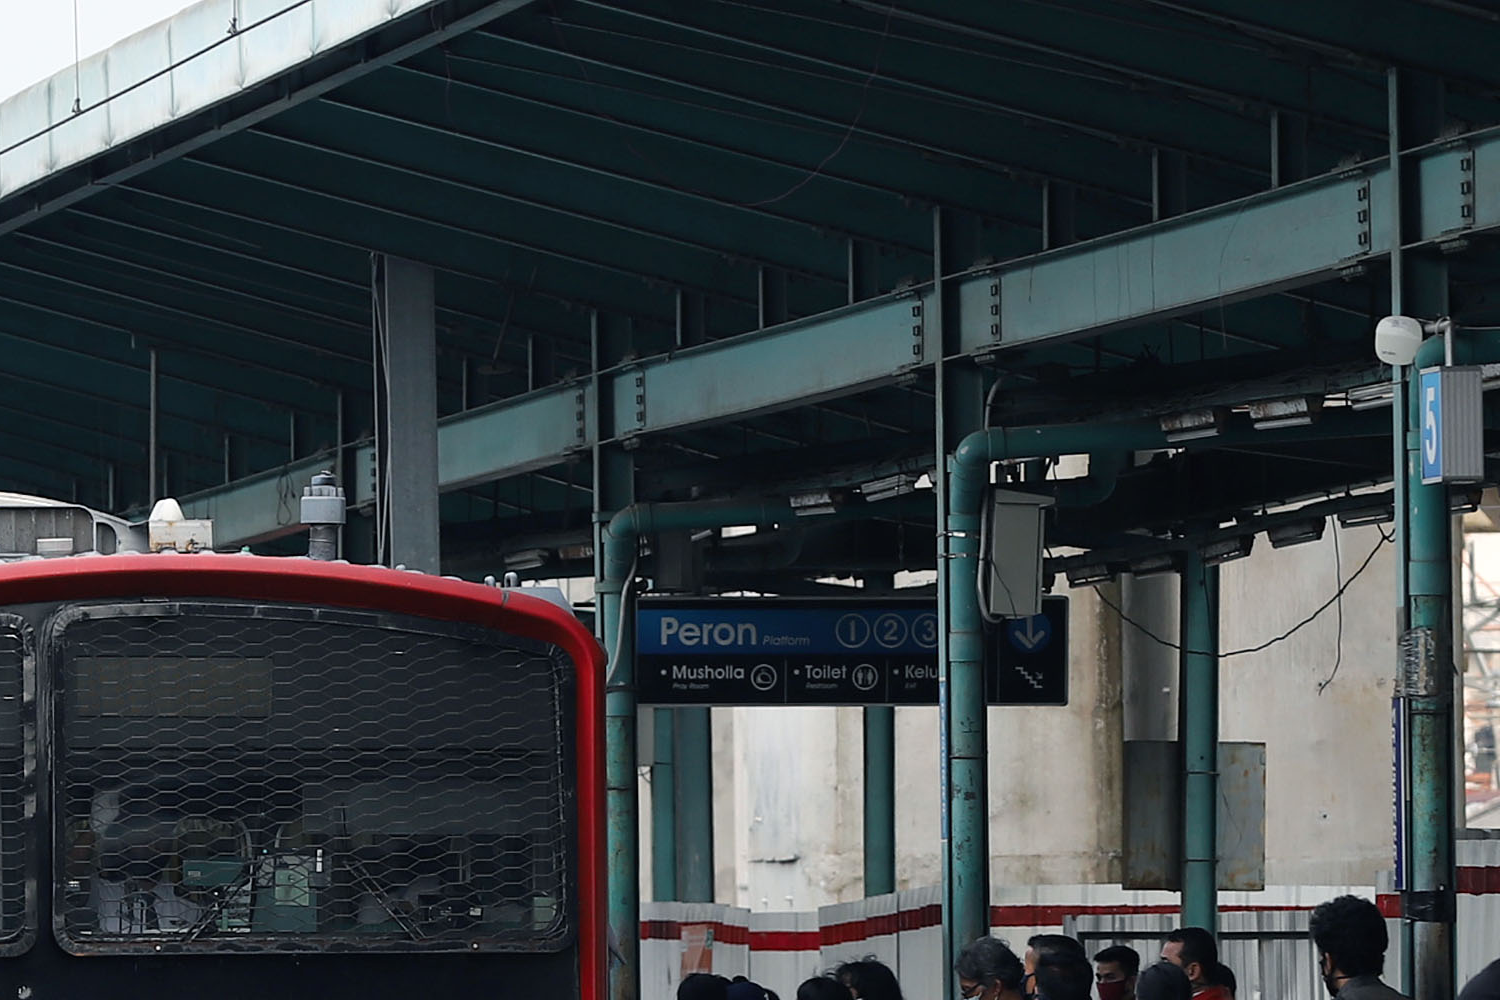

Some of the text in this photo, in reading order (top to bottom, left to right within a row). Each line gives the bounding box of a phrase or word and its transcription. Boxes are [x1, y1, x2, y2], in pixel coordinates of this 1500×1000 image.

[1425, 387, 1437, 465] 5
[660, 616, 757, 646] Peron
[762, 635, 811, 646] Platform
[672, 664, 745, 680] Musholla
[805, 664, 847, 680] Toilet
[904, 664, 938, 680] Kelu
